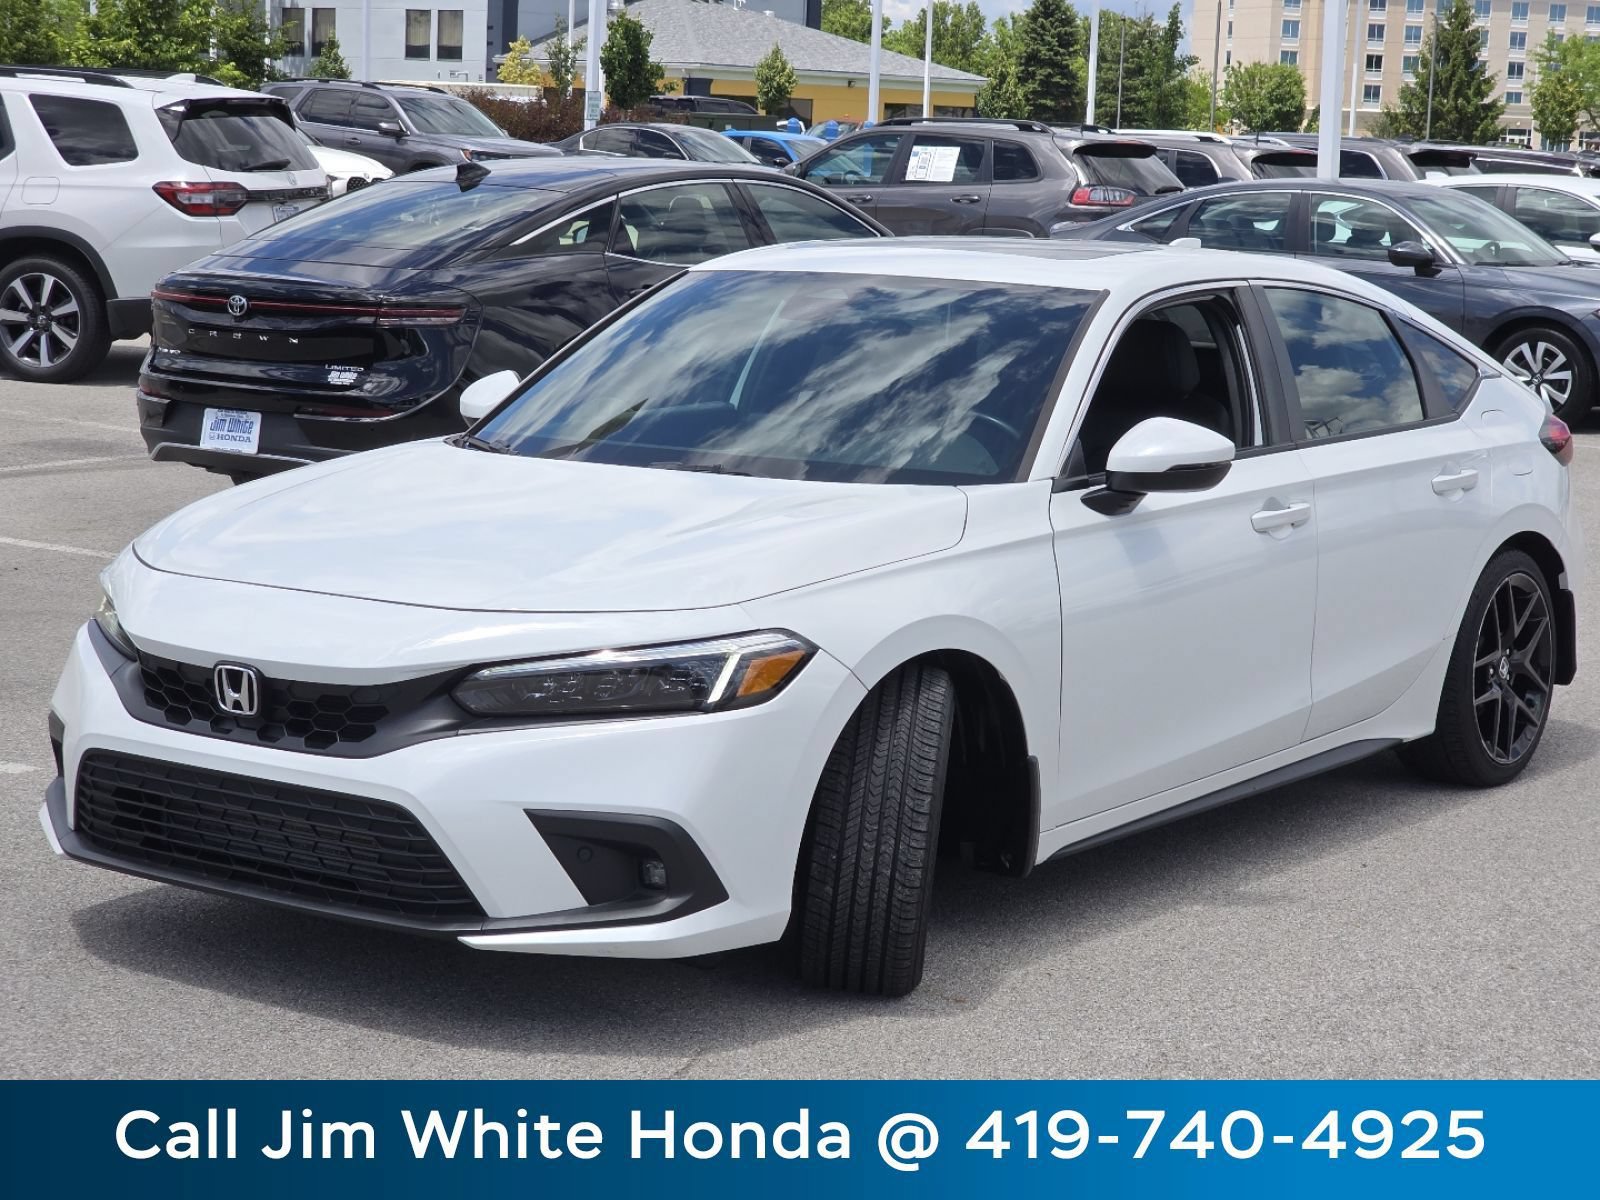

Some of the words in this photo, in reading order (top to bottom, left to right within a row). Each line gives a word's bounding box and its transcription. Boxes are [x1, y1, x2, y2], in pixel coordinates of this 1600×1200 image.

[210, 416, 227, 431] Jim
[227, 418, 254, 434] White
[216, 434, 251, 442] HONDA
